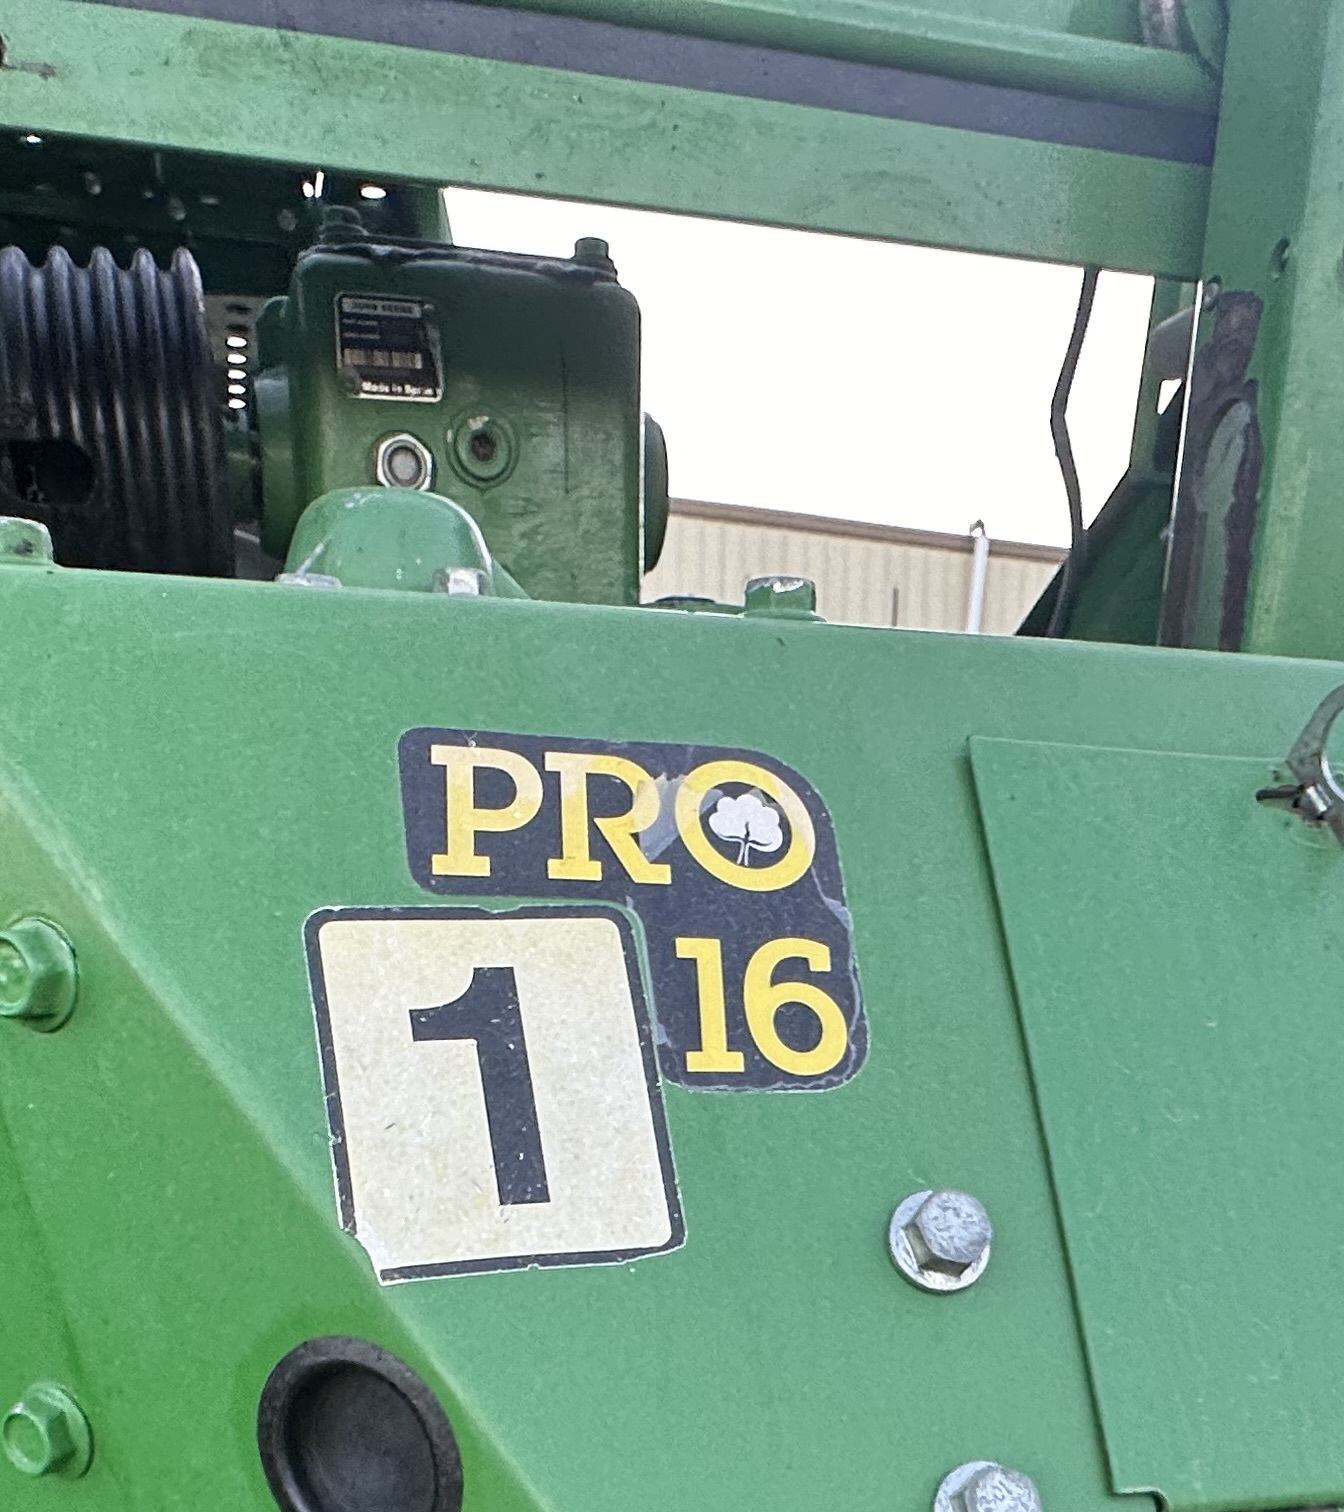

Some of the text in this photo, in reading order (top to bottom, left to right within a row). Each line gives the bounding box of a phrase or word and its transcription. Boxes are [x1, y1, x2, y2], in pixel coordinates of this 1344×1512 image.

[430, 744, 816, 892] PRO
[675, 937, 849, 1076] 16
[409, 966, 551, 1207] 1
